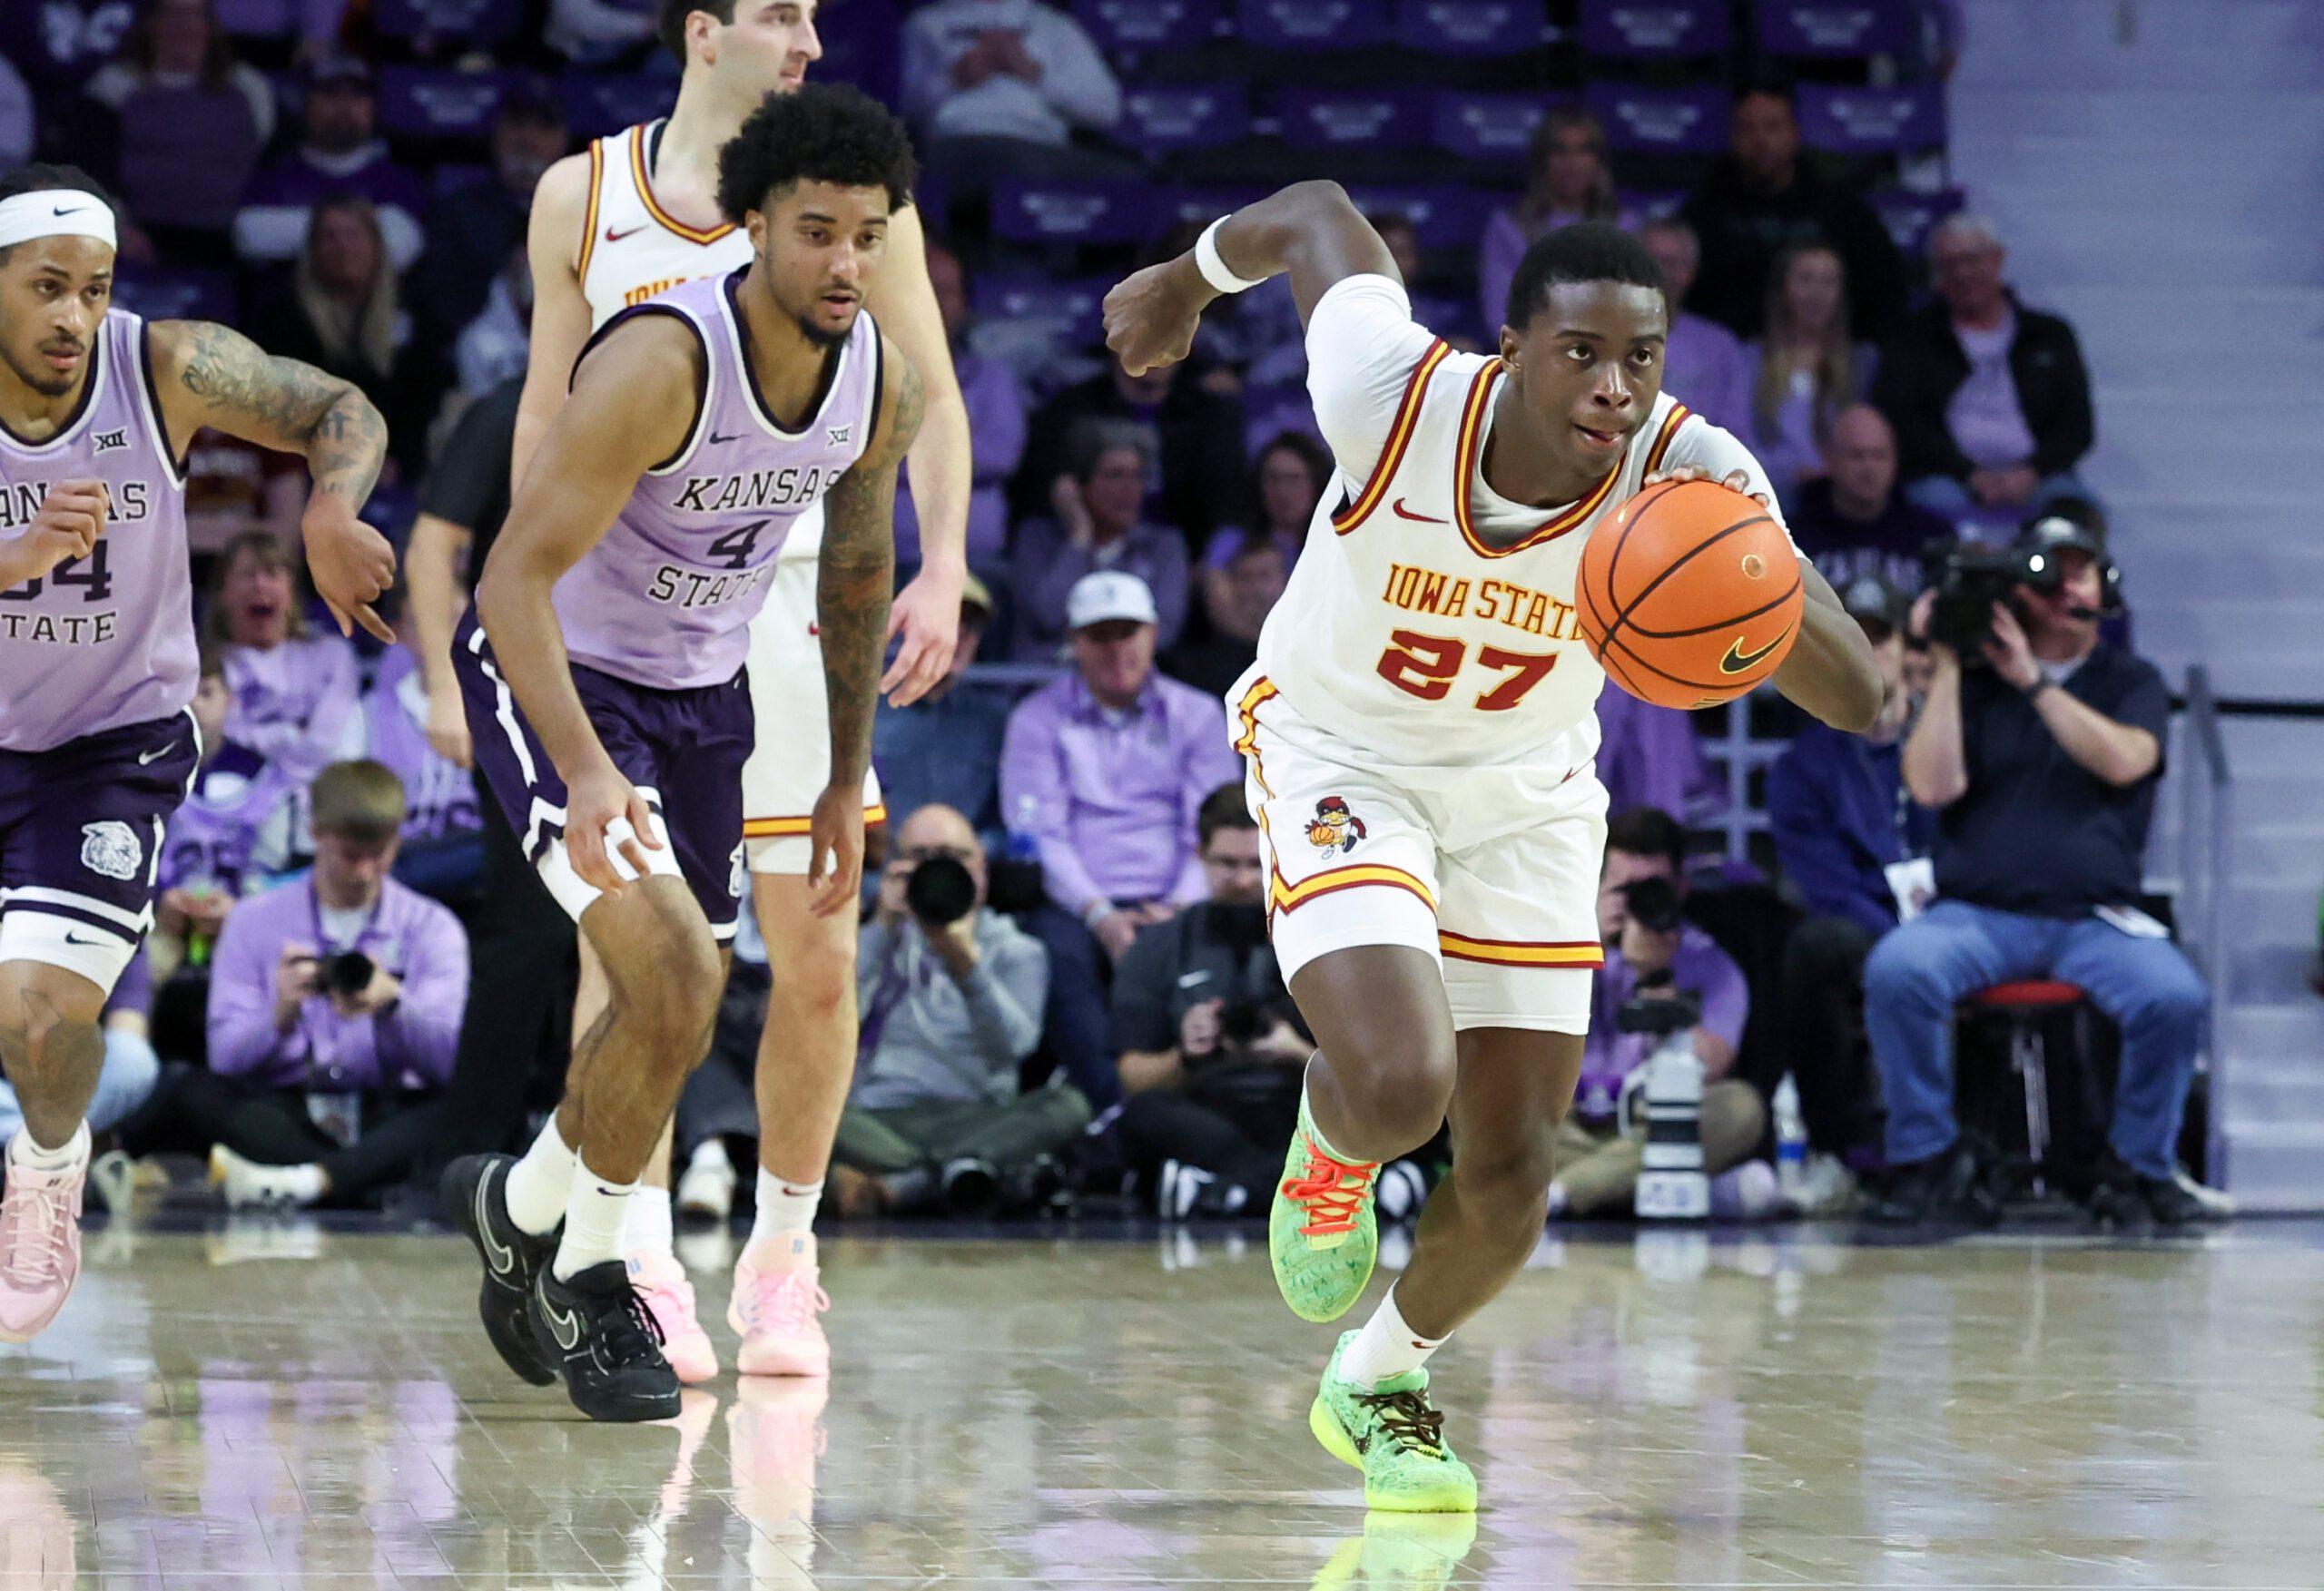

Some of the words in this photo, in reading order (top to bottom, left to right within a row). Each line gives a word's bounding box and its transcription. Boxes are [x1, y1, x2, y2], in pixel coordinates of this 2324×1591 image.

[706, 518, 772, 569] 4
[1382, 562, 1472, 617] IOWA
[0, 611, 117, 644] TATE
[1375, 627, 1560, 712] 27
